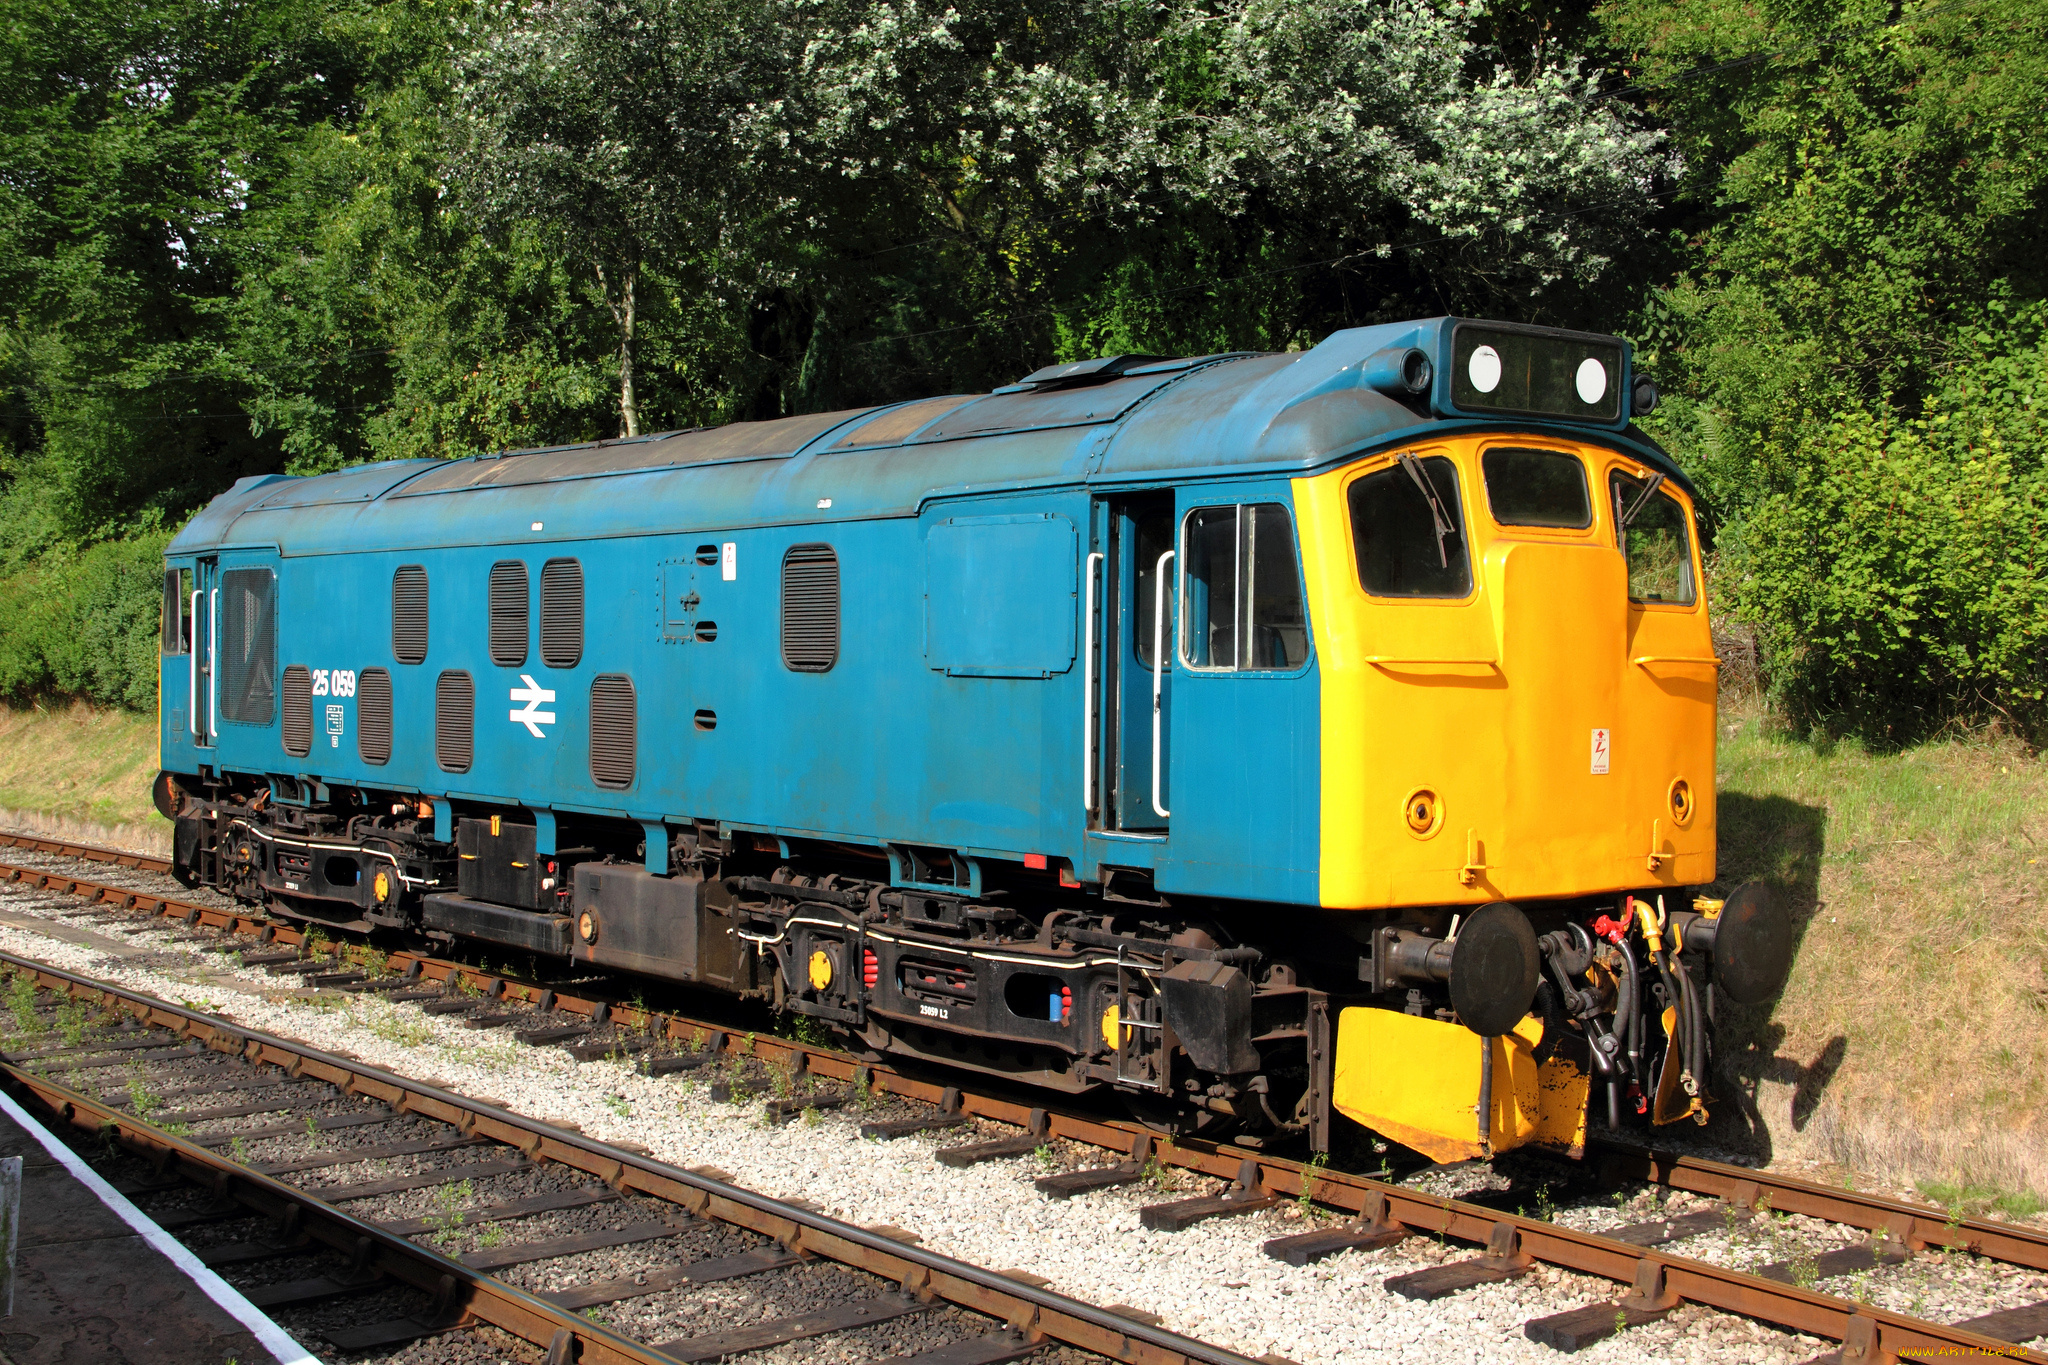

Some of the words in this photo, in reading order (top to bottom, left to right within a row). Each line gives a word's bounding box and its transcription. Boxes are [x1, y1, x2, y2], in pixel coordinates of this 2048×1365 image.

[312, 669, 329, 696] 25
[331, 669, 356, 697] 059
[920, 1005, 938, 1017] 25059
[939, 1008, 948, 1019] L2
